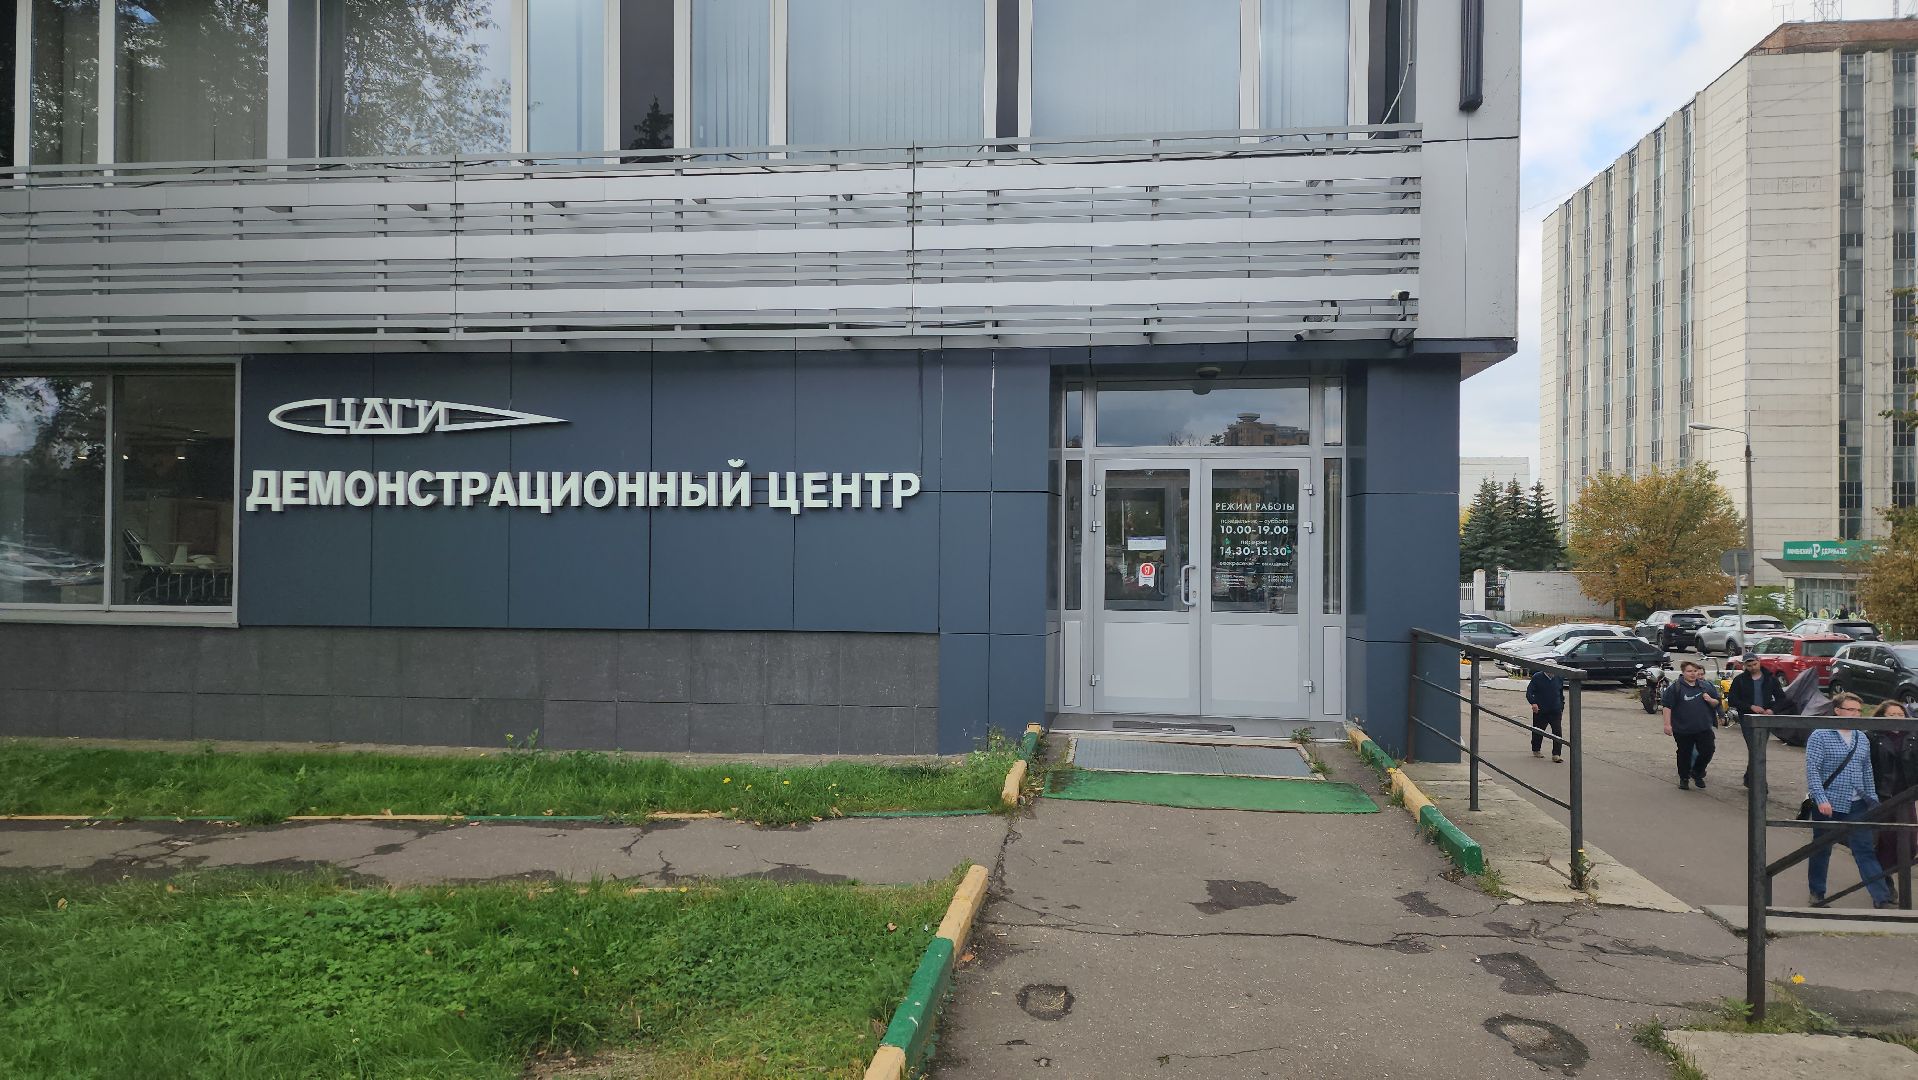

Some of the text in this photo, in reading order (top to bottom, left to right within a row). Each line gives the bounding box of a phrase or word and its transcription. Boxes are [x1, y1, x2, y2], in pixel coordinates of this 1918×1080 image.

[324, 398, 450, 434] ЦАГИ
[246, 458, 921, 515] ДЕМОНСТРАЦИОННЫЙ ЦЕНТР
[1215, 502, 1295, 511] РЕЖИМ РАБОТЫ
[1220, 525, 1289, 535] 10.00-19.00
[1219, 546, 1287, 556] 14.30-15.30
